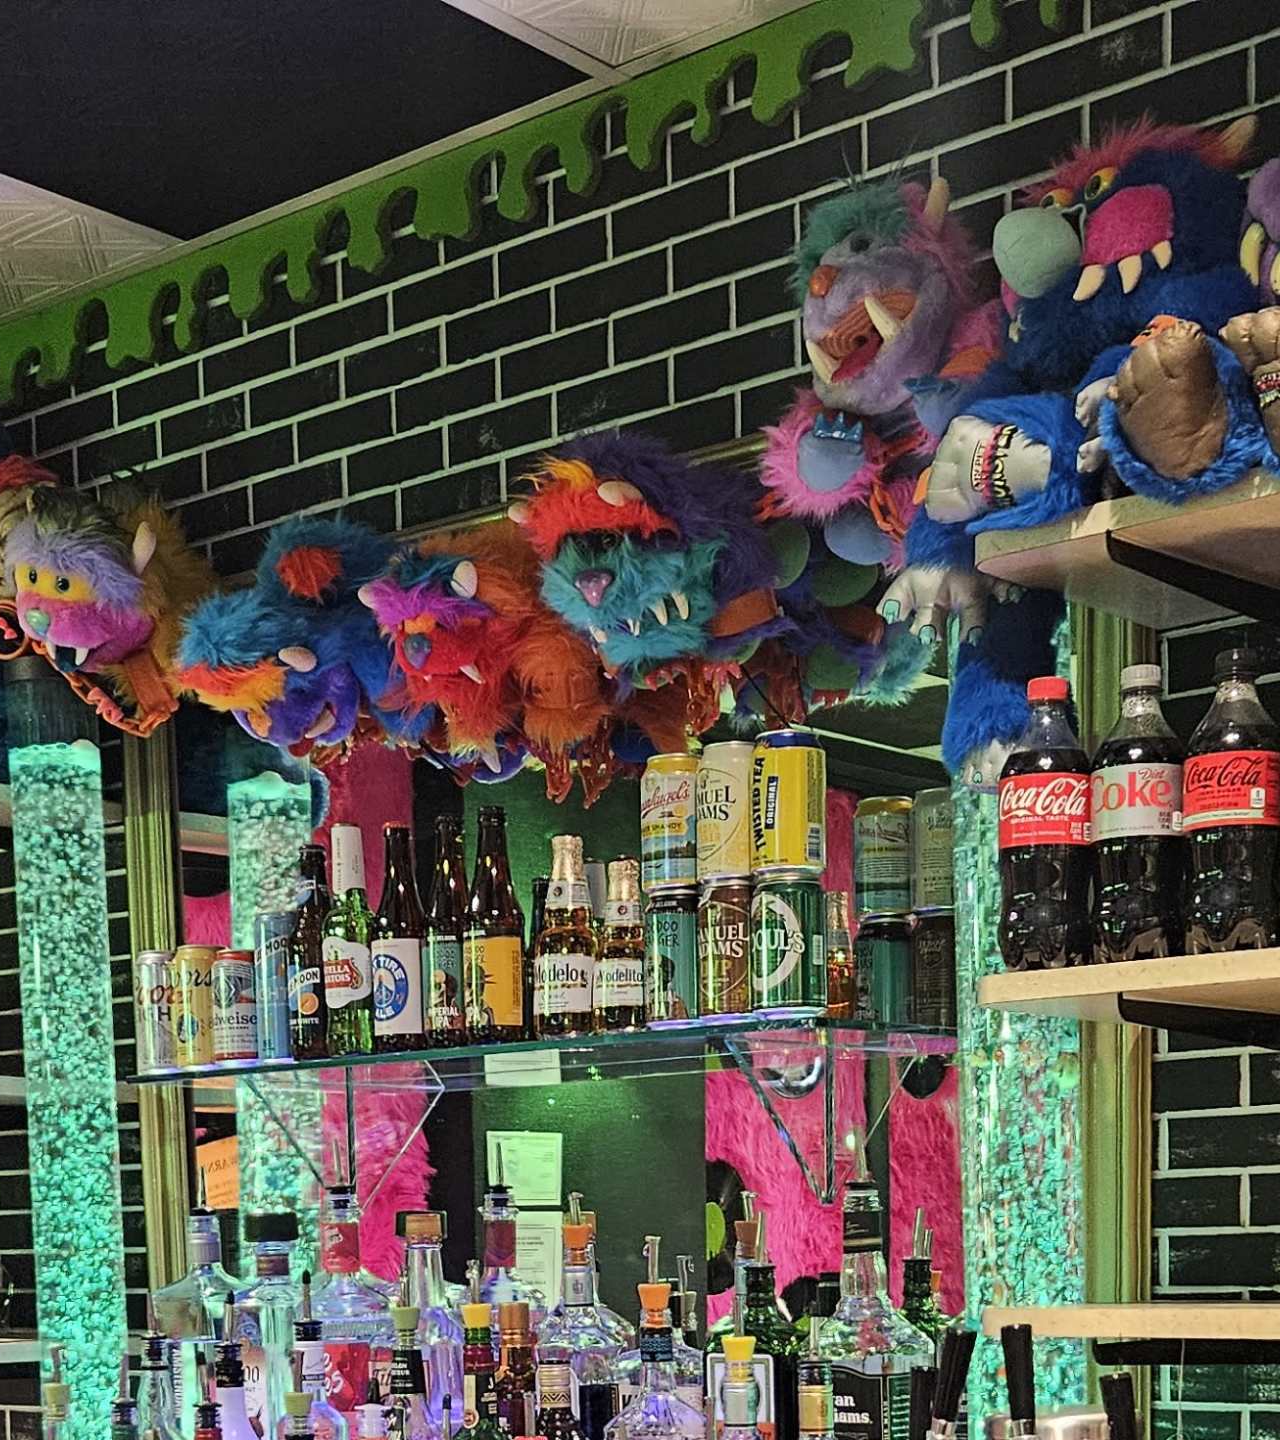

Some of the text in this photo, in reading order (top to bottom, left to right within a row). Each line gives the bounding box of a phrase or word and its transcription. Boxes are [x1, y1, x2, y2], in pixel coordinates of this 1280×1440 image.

[1138, 767, 1165, 781] Diet
[1186, 756, 1263, 793] Coca-Cola
[697, 786, 736, 805] MUEL
[1000, 777, 1089, 819] Coca-Cola
[1091, 772, 1172, 813] Coke
[697, 803, 730, 821] AMS
[752, 756, 766, 851] TWISTED TEA
[767, 779, 778, 826] ORIGINAL
[1010, 815, 1045, 824] ORIGINAL
[699, 921, 749, 942] AMUEL
[752, 928, 805, 953] OUL'S
[699, 940, 744, 959] DAMS
[324, 964, 351, 974] ELLA
[378, 955, 406, 980] TIRE
[324, 973, 352, 984] TOIS
[833, 1394, 855, 1407] an
[833, 1408, 873, 1424] iams.
